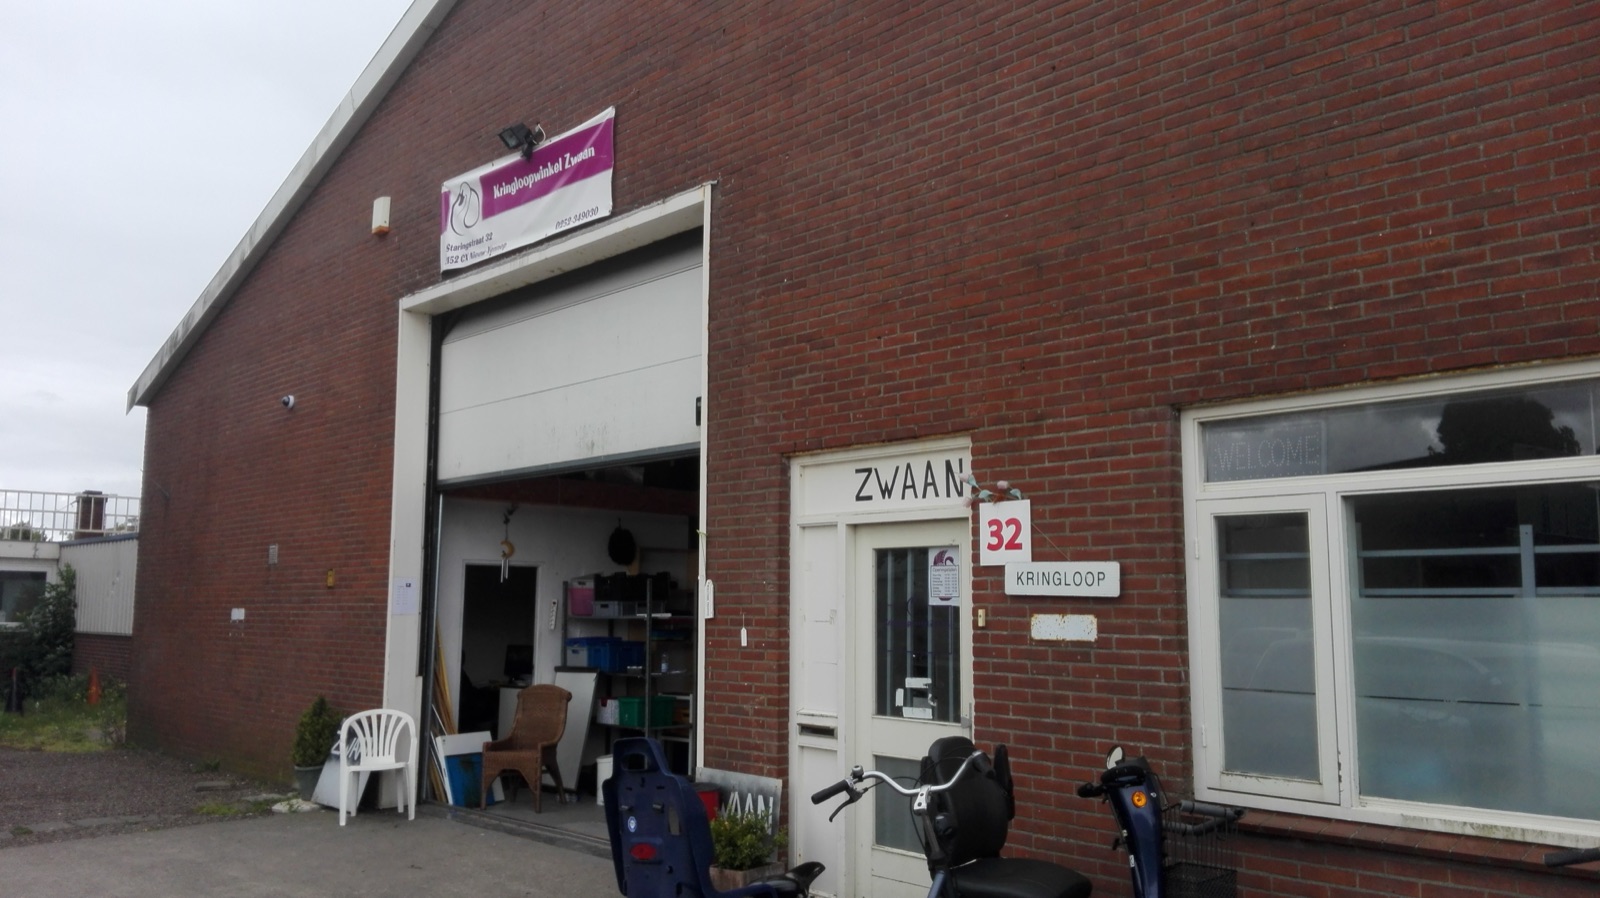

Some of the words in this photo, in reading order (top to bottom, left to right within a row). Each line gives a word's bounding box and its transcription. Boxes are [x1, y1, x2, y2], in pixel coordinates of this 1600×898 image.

[493, 157, 563, 199] Kringloopwinkel
[564, 146, 595, 170] Zwaan
[485, 231, 493, 242] 32
[1217, 435, 1317, 471] WELCOME
[855, 458, 964, 502] ZWAAN
[986, 517, 1023, 551] 32
[1016, 571, 1106, 587] KRINGLOOP
